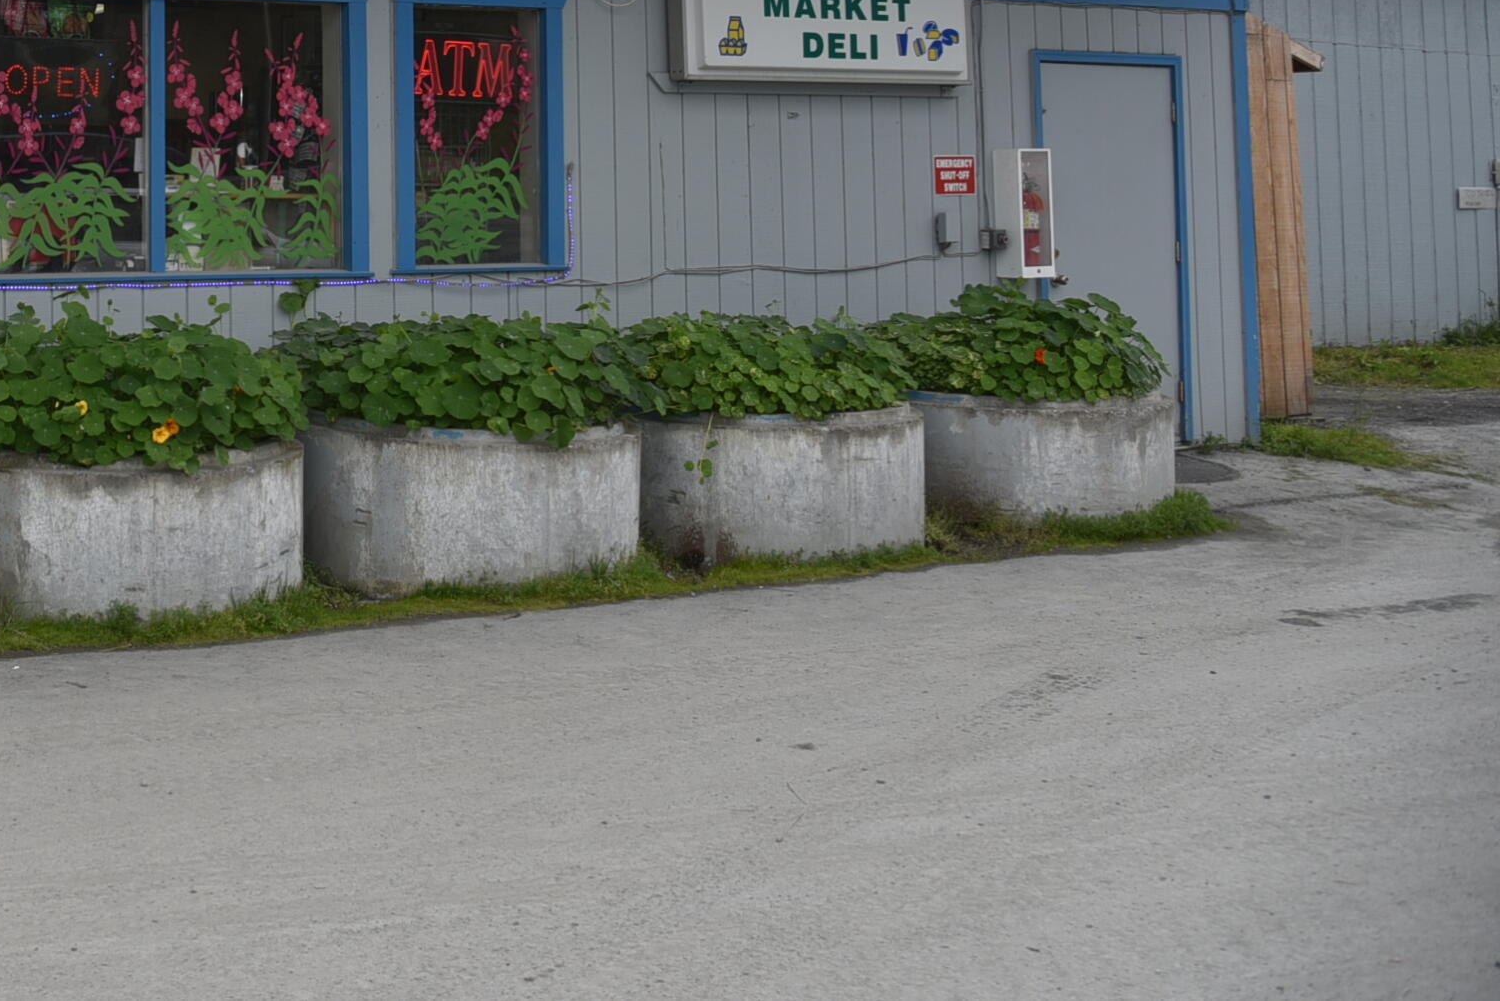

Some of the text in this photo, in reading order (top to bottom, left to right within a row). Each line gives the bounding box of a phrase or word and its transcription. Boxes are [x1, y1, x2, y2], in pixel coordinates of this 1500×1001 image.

[802, 32, 879, 60] DELI
[414, 39, 512, 98] ATM
[5, 64, 100, 98] OPEN
[936, 159, 972, 168] EMERGENCY
[940, 170, 970, 180] SHUT-OFF
[944, 182, 967, 192] SWITCH
